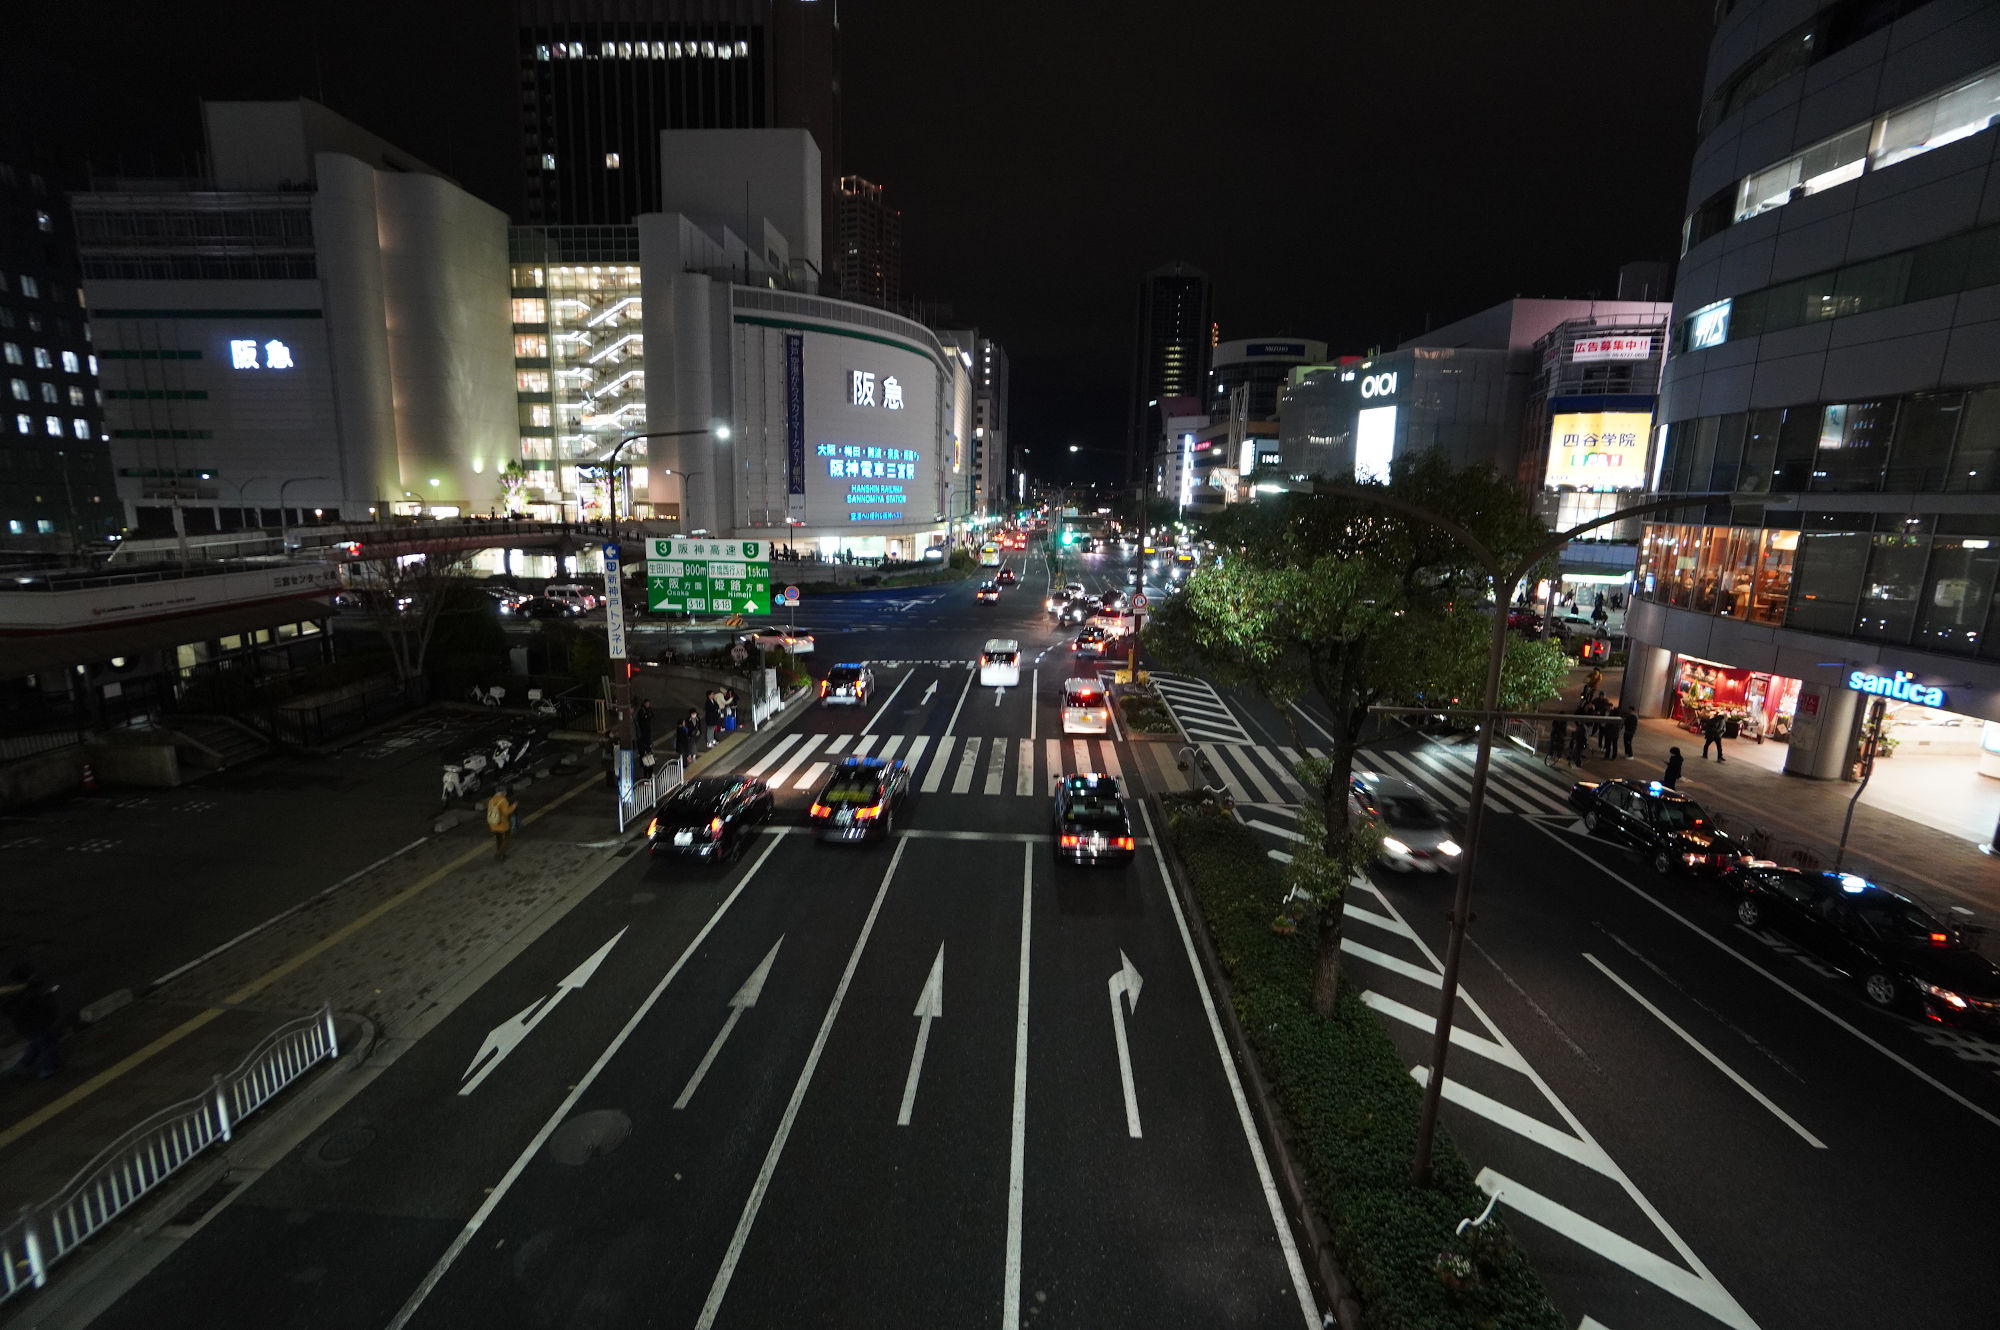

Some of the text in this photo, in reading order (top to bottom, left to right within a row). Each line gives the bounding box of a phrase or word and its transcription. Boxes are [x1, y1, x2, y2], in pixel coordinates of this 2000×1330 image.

[231, 340, 294, 369] 阪急
[853, 370, 904, 410] 阪急
[1563, 432, 1636, 448] 四谷学院
[851, 484, 880, 493] HANSHIN
[847, 494, 907, 504] SANNOMIYA STATION
[659, 542, 668, 553] 3
[677, 543, 737, 556] 阪神高速
[746, 543, 755, 555] 3
[649, 562, 707, 576] 生田川入口 900m
[653, 578, 703, 590] 大阪方面
[714, 579, 764, 592] 姫路方面
[666, 589, 690, 597] Osaka
[727, 591, 751, 599] Himeji
[608, 574, 622, 656] 新神戸トンネル
[1848, 670, 1944, 708] santica
